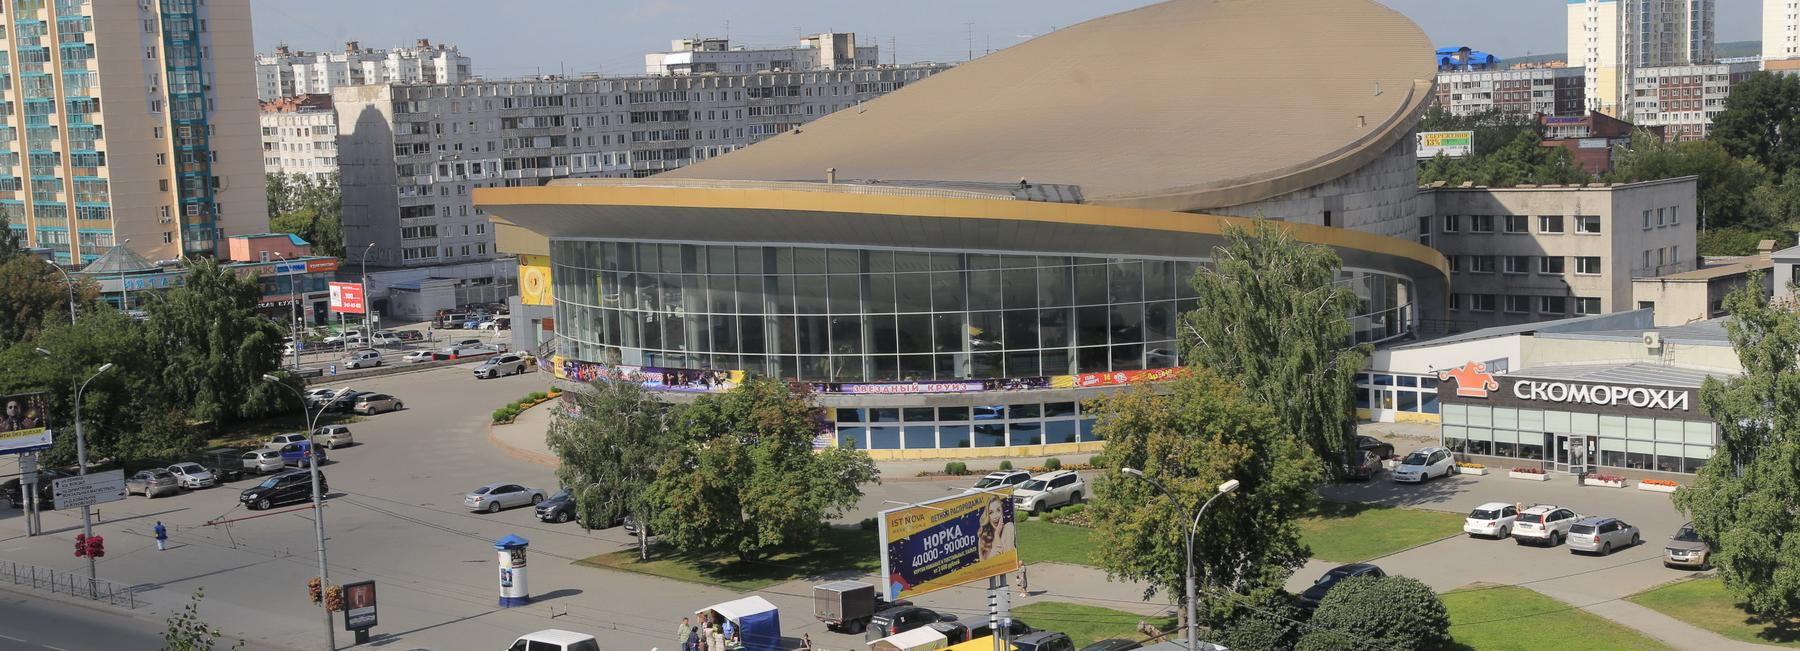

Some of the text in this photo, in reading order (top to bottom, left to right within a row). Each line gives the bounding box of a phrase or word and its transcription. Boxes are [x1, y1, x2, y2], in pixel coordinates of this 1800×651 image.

[853, 382, 968, 393] ЗВЕЗДНЫЙ КРУИЗ
[1513, 380, 1688, 411] СКОМОРОХИ
[924, 525, 962, 551] НОРКА
